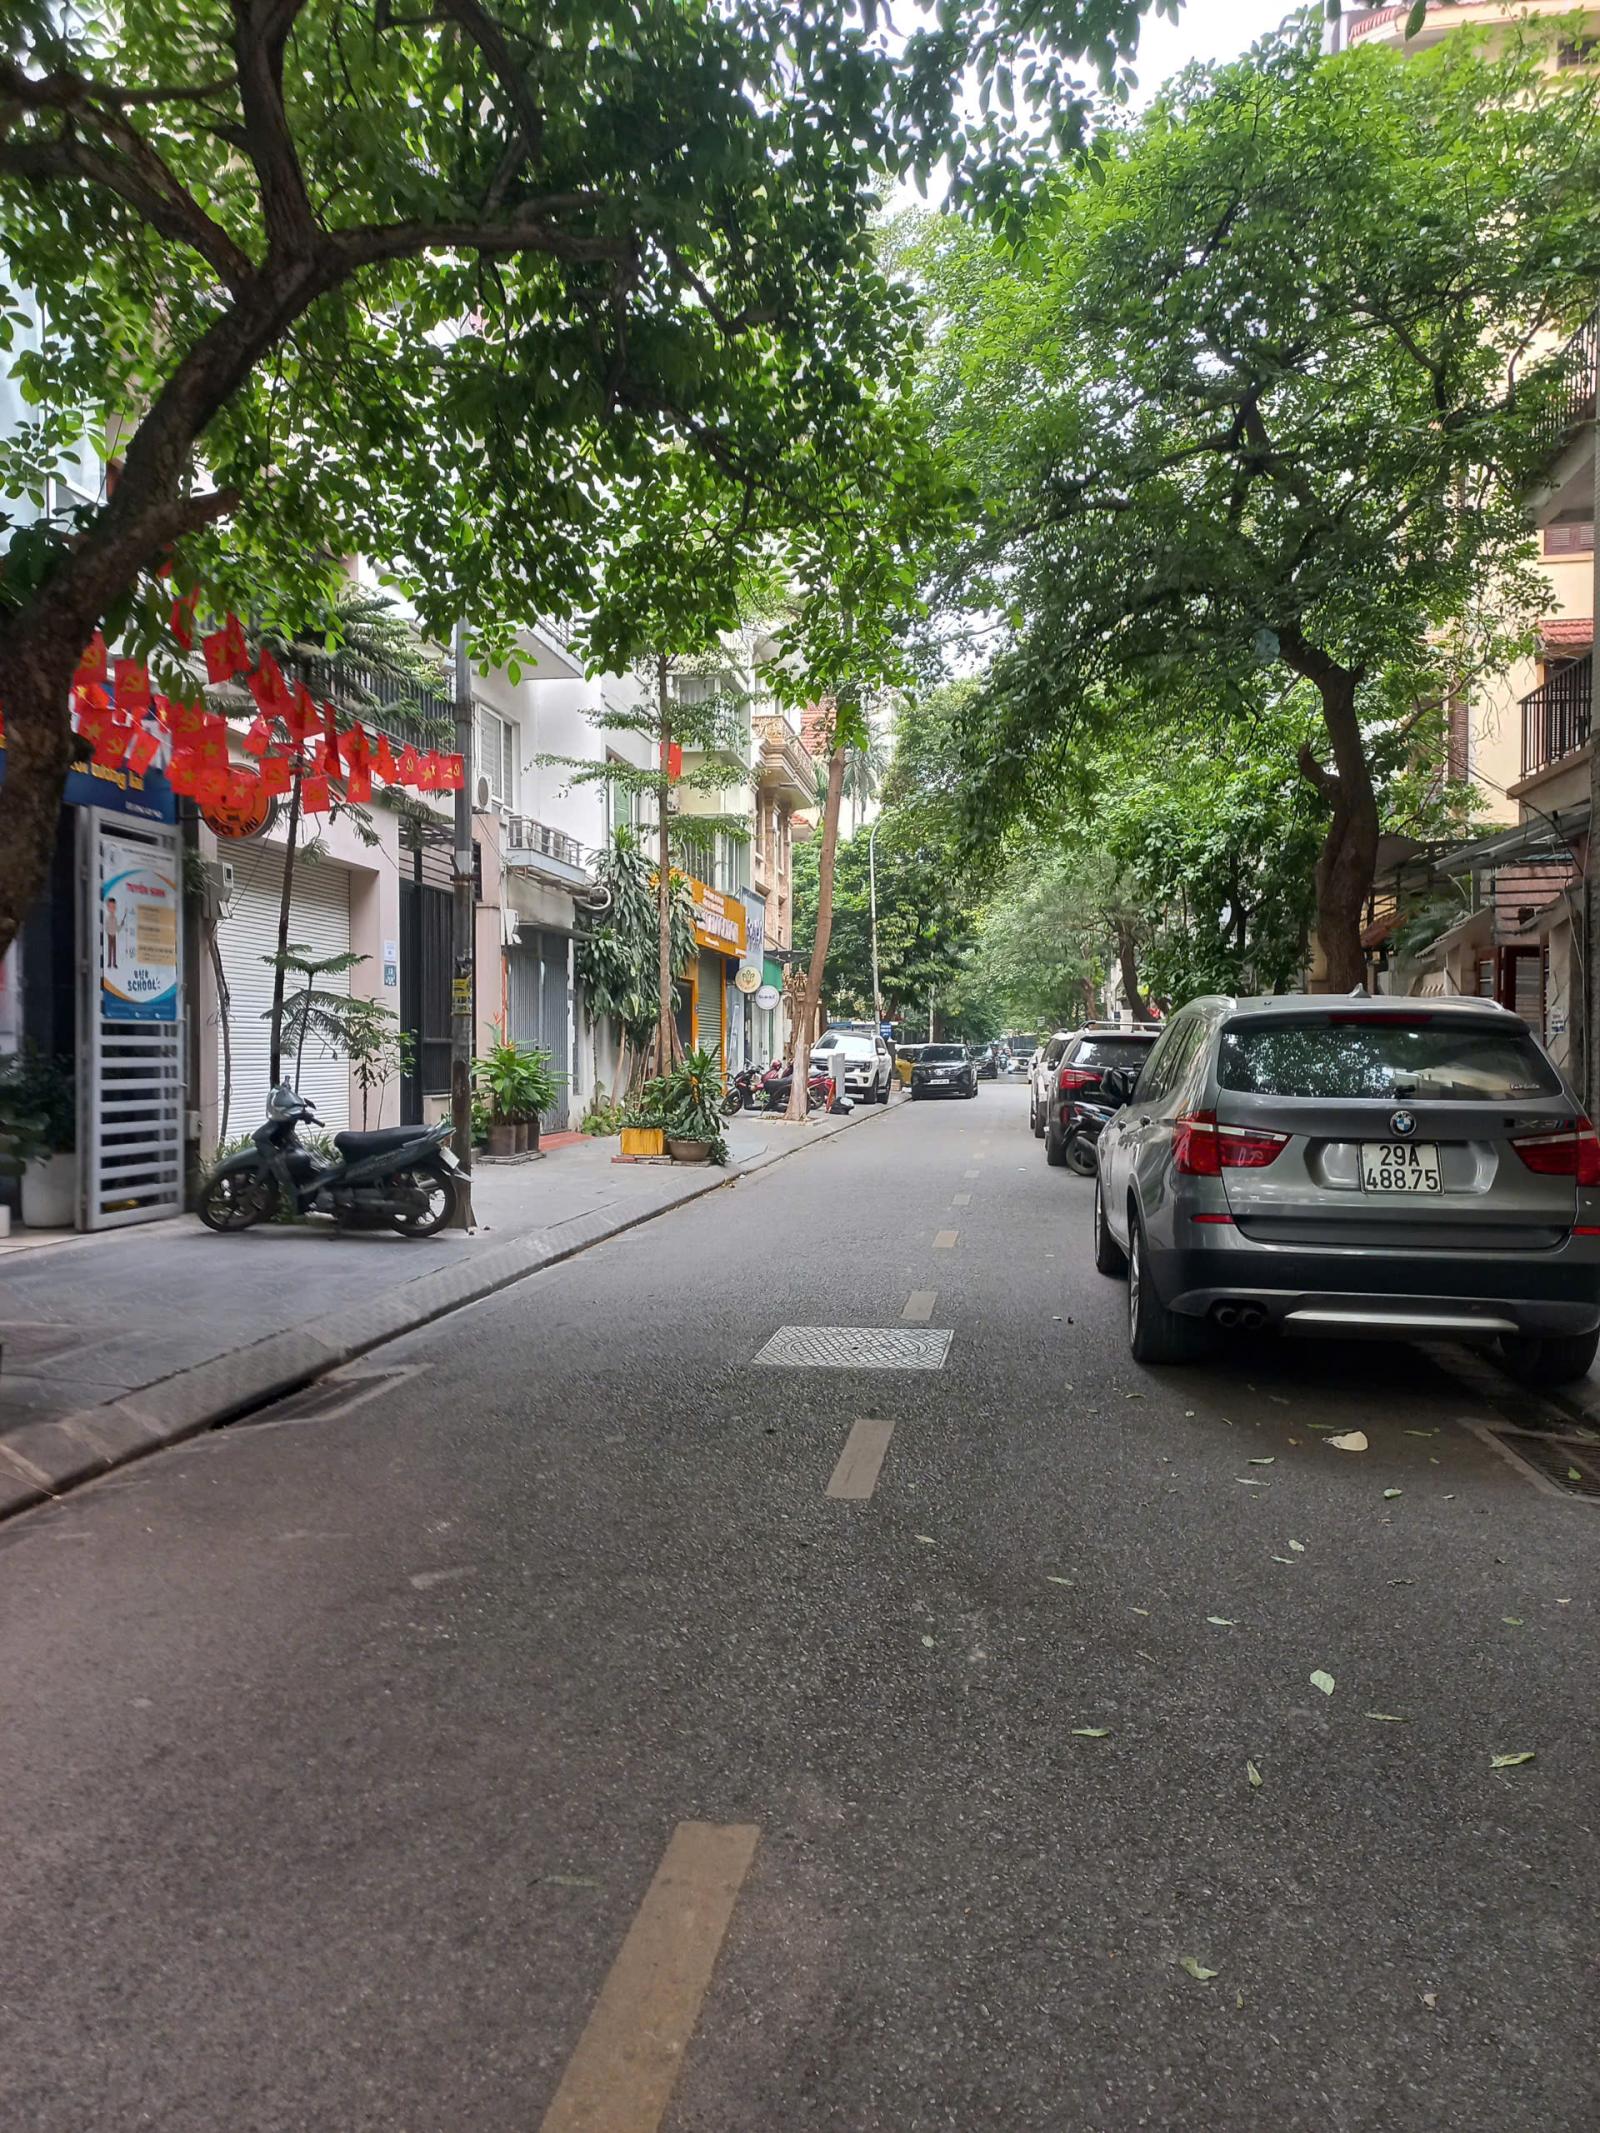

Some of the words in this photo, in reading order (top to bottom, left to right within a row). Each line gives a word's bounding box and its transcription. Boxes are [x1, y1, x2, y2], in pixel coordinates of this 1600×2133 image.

[127, 978, 156, 991] SCHOOL
[1379, 1145, 1420, 1167] 29A
[1366, 1168, 1438, 1190] 488.75
